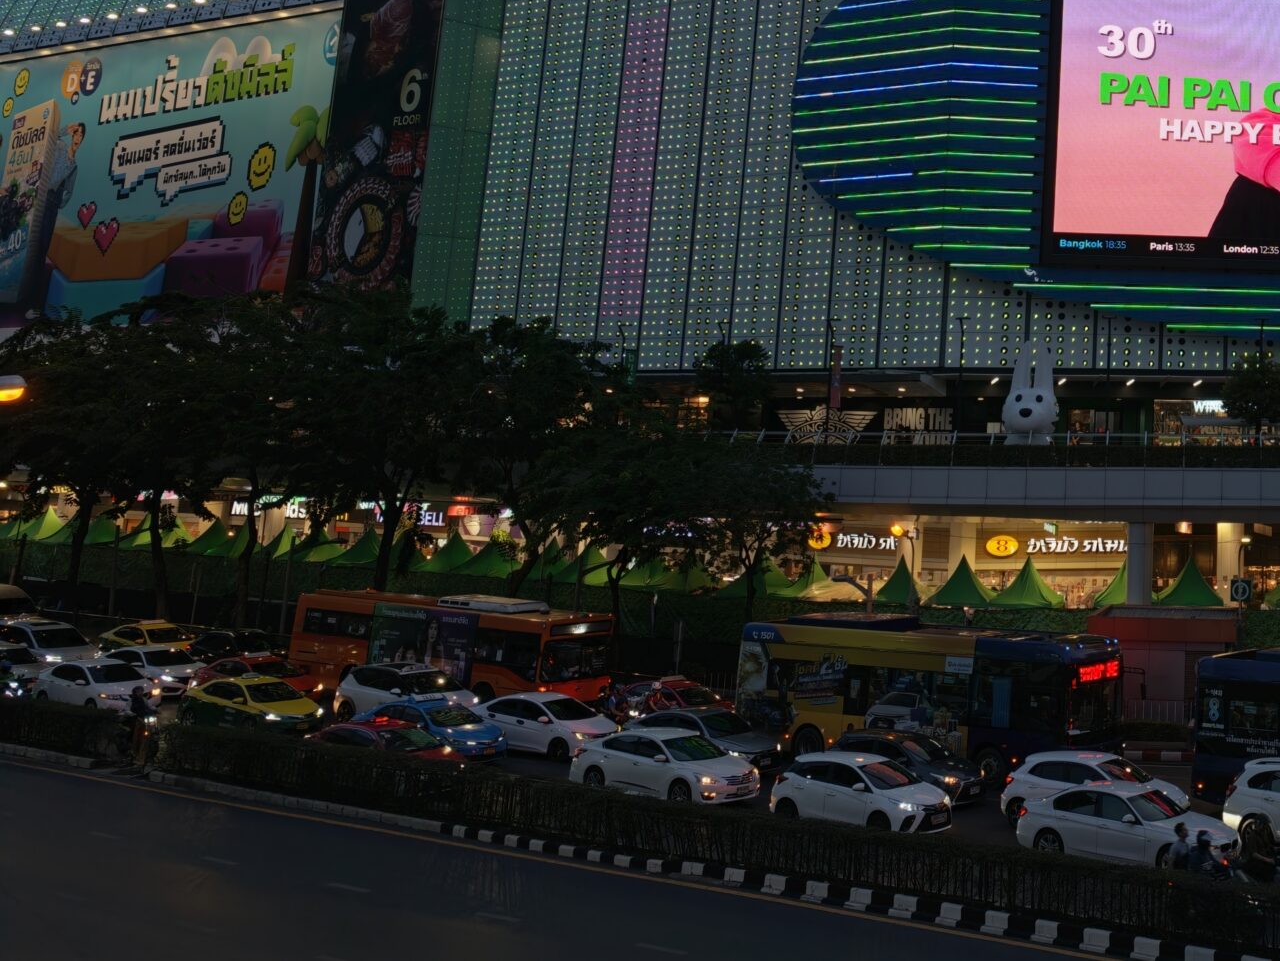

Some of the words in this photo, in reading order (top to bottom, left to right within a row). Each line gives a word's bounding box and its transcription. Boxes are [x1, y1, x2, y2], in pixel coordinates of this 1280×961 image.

[1097, 19, 1174, 60] 30th
[1100, 72, 1169, 108] PAI
[1183, 77, 1251, 112] PAI
[392, 113, 421, 126] FLOOR
[1159, 117, 1266, 145] HAPPY
[1059, 239, 1103, 251] Bangkok
[1105, 240, 1127, 250] 18:35
[1150, 242, 1174, 251] Paris
[1175, 243, 1196, 252] 13:35
[1223, 244, 1258, 254] London
[1260, 245, 1280, 255] 12:35
[884, 407, 925, 430] BRING
[927, 407, 953, 430] THE
